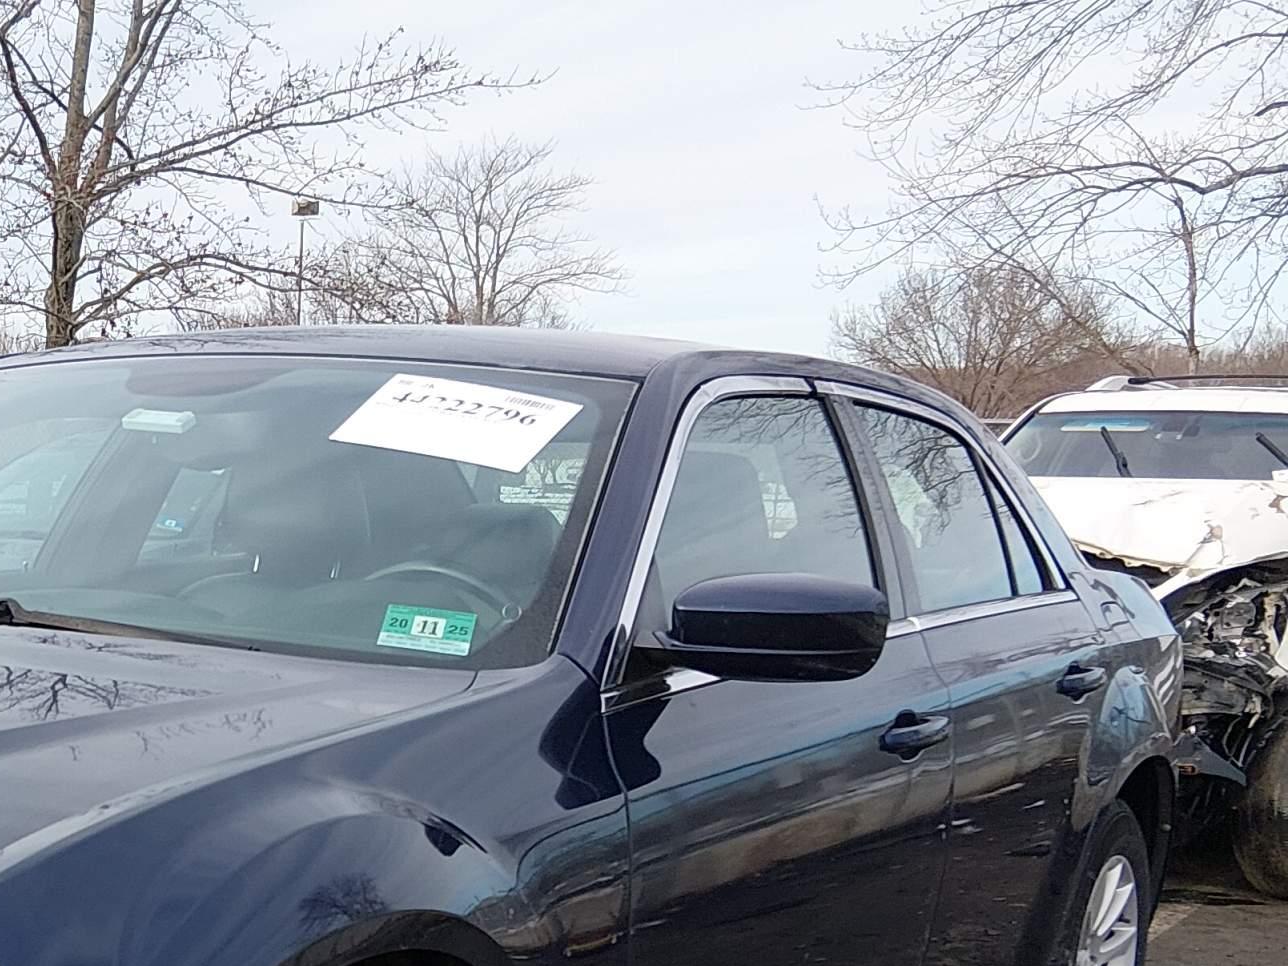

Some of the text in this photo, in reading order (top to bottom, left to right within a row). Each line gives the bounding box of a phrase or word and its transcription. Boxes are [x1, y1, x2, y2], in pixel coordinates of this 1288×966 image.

[389, 617, 469, 637] 20 11 25
